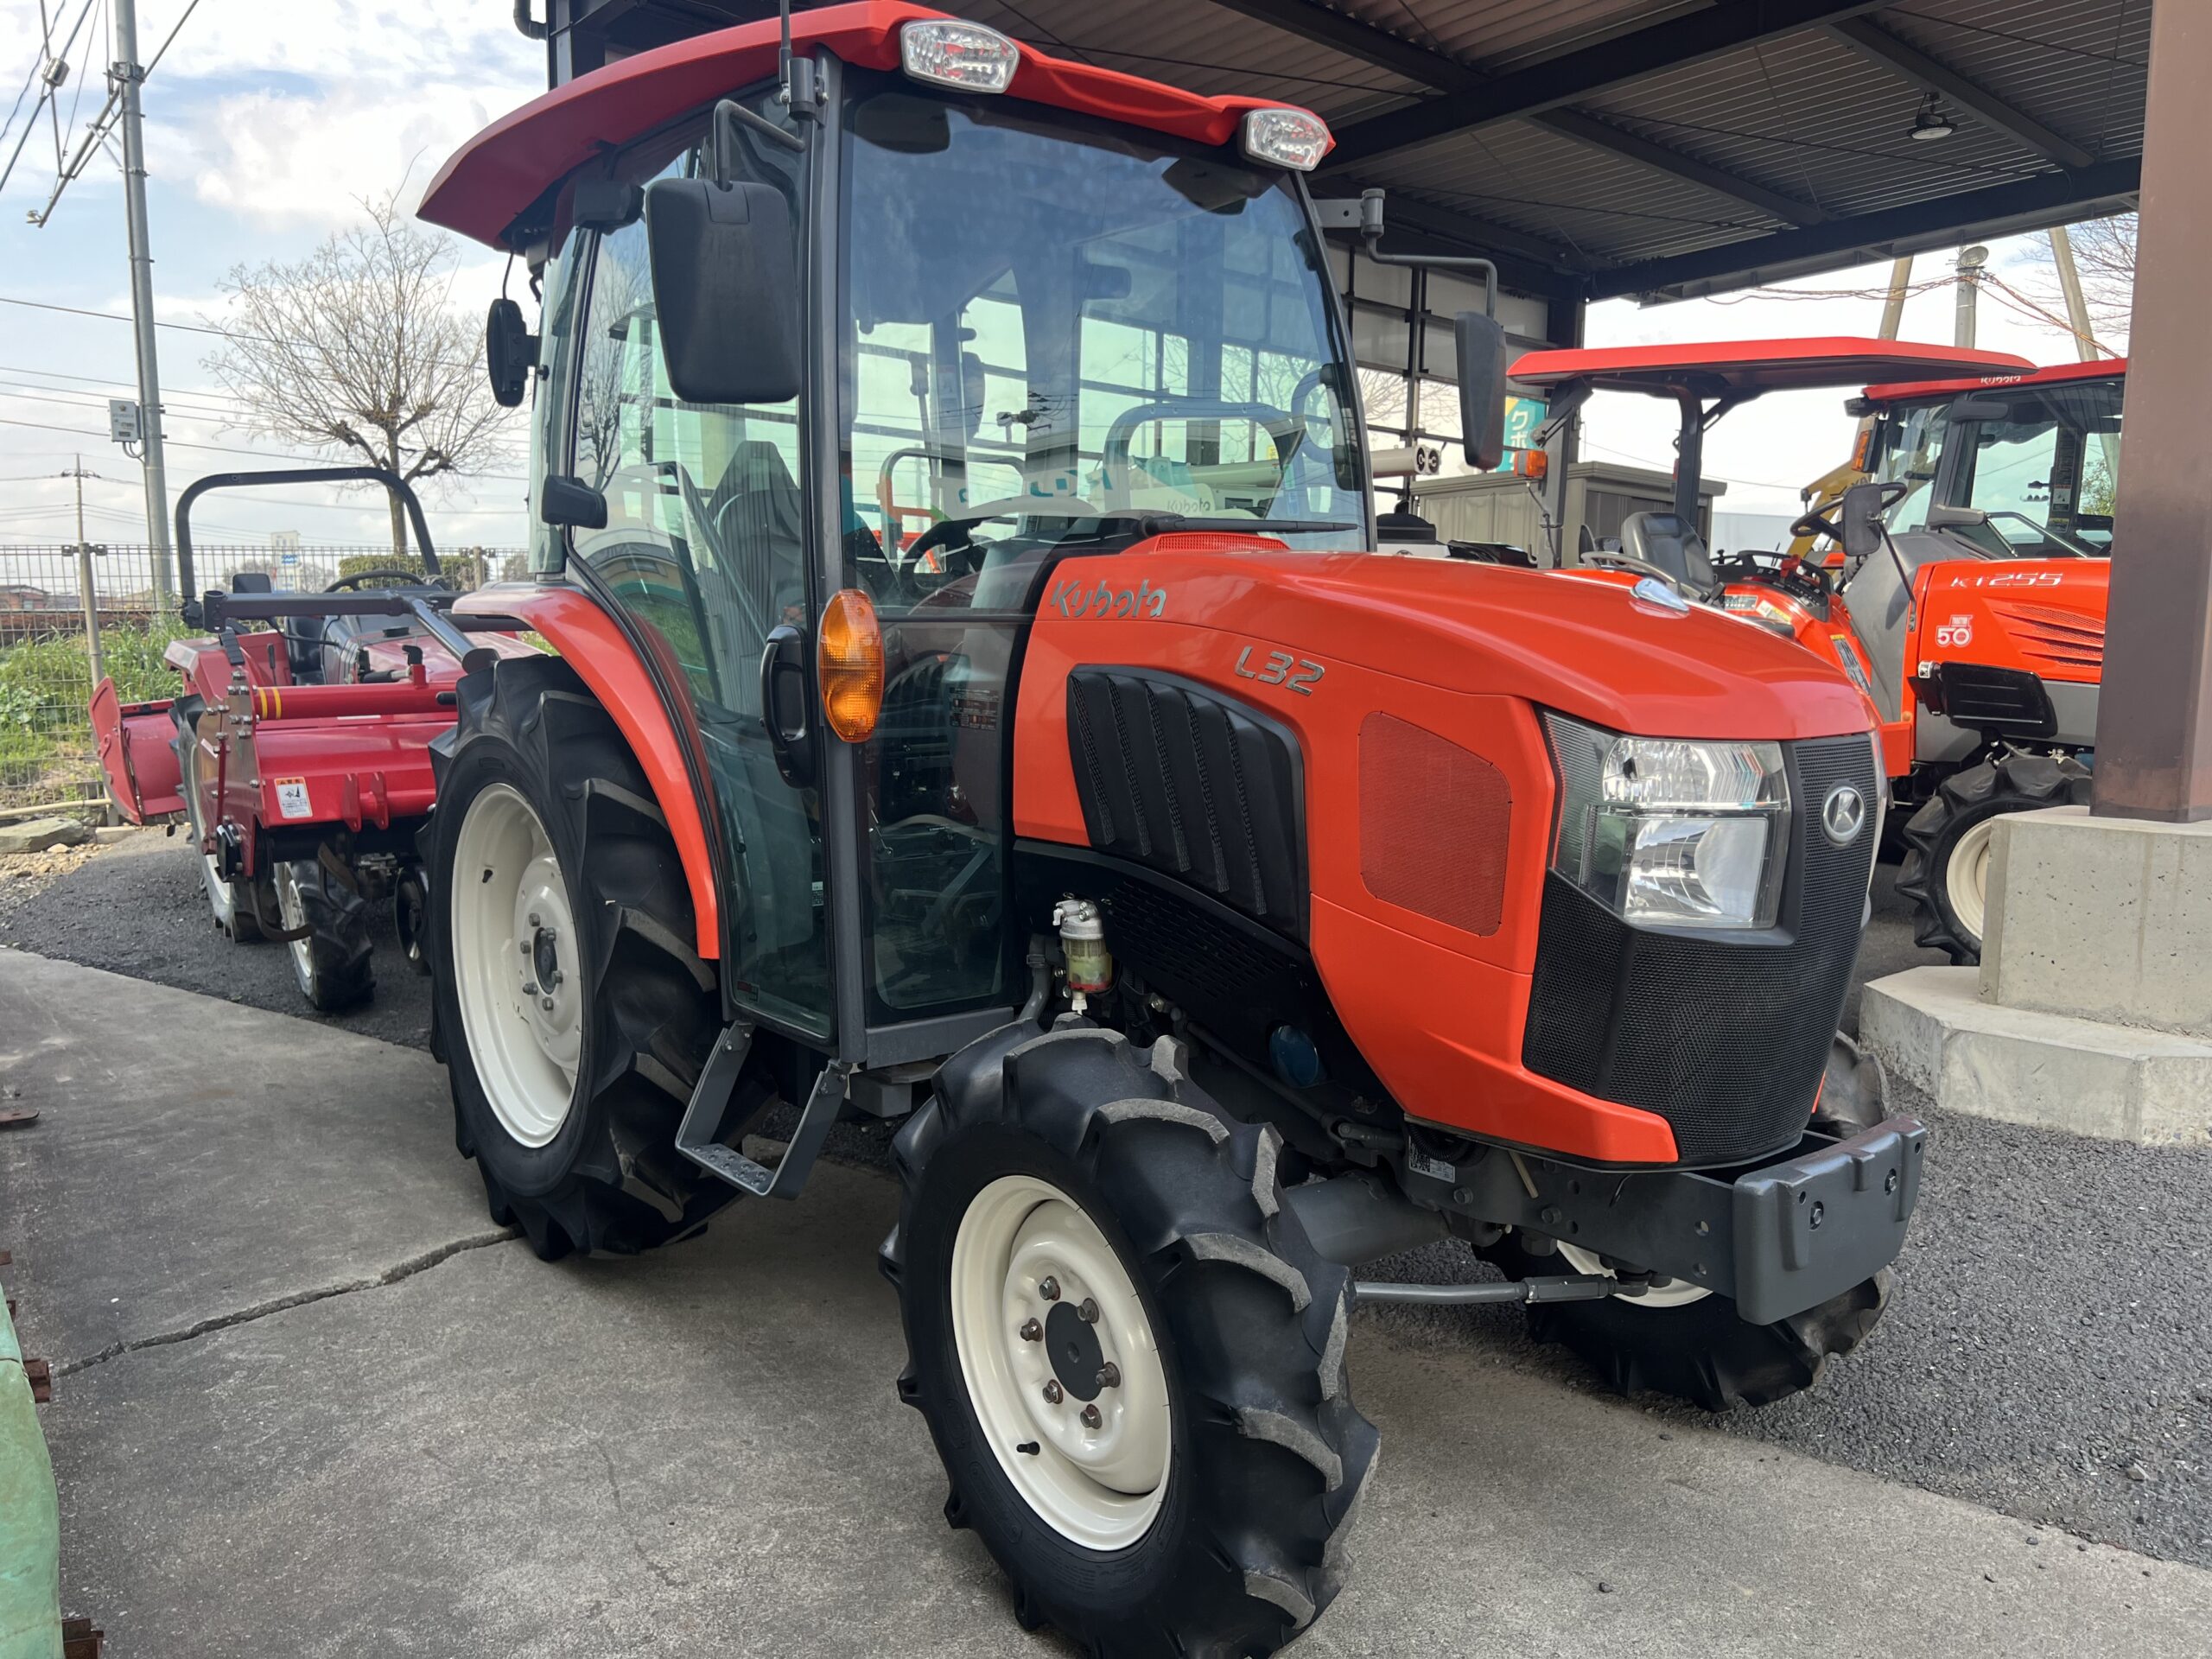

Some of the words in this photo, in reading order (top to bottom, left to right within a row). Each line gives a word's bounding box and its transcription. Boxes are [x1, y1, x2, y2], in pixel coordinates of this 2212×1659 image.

[1167, 497, 1211, 513] Kubota
[1050, 579, 1166, 617] Kubota
[1937, 627, 1970, 645] 50
[1234, 645, 1325, 696] L32
